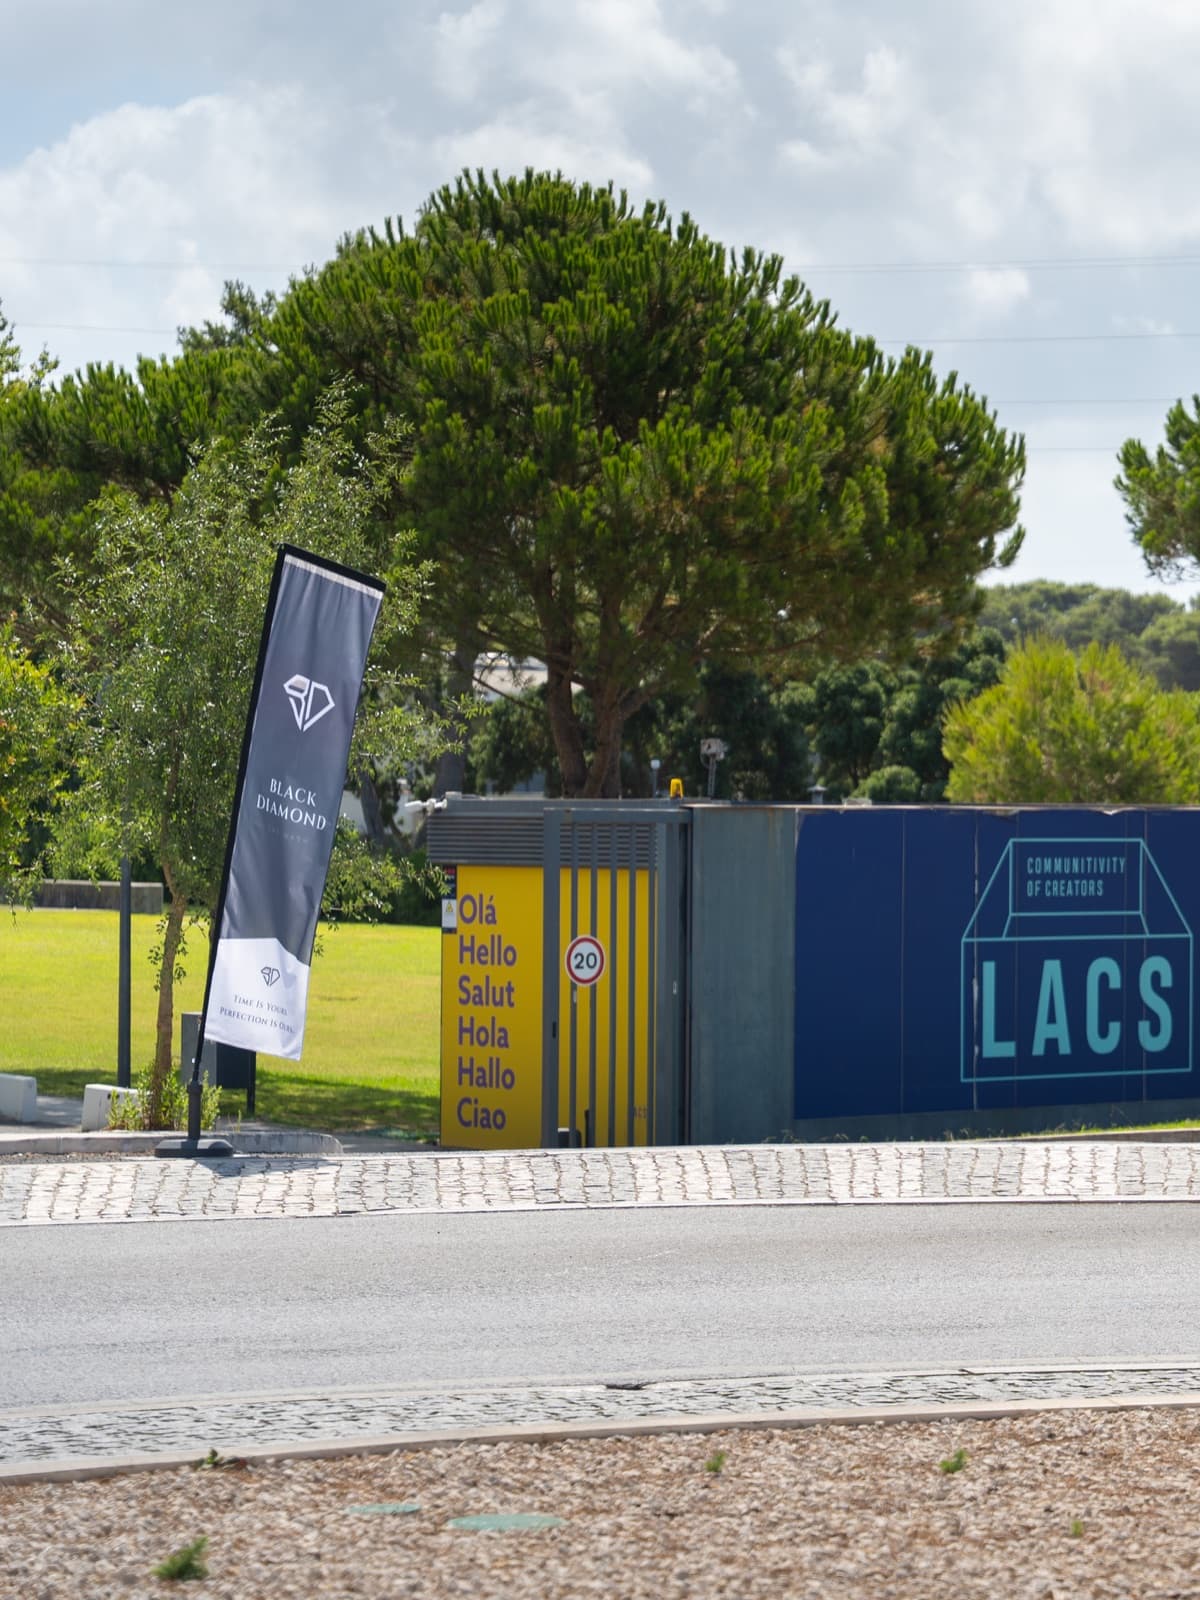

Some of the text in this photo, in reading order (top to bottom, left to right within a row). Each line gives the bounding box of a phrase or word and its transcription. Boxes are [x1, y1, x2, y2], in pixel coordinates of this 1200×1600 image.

[270, 778, 317, 807] BLACK
[256, 794, 327, 830] DIAMOND
[1027, 857, 1126, 874] COMMUNITIVITY
[1027, 879, 1104, 897] OF CREATORS
[459, 893, 497, 925] Olá
[458, 934, 517, 967] Hello
[574, 952, 597, 970] 20
[458, 975, 515, 1008] Salut
[982, 955, 1173, 1059] LACS
[458, 1015, 510, 1049] Hola
[458, 1056, 515, 1090] Hallo
[457, 1097, 506, 1130] Ciao
